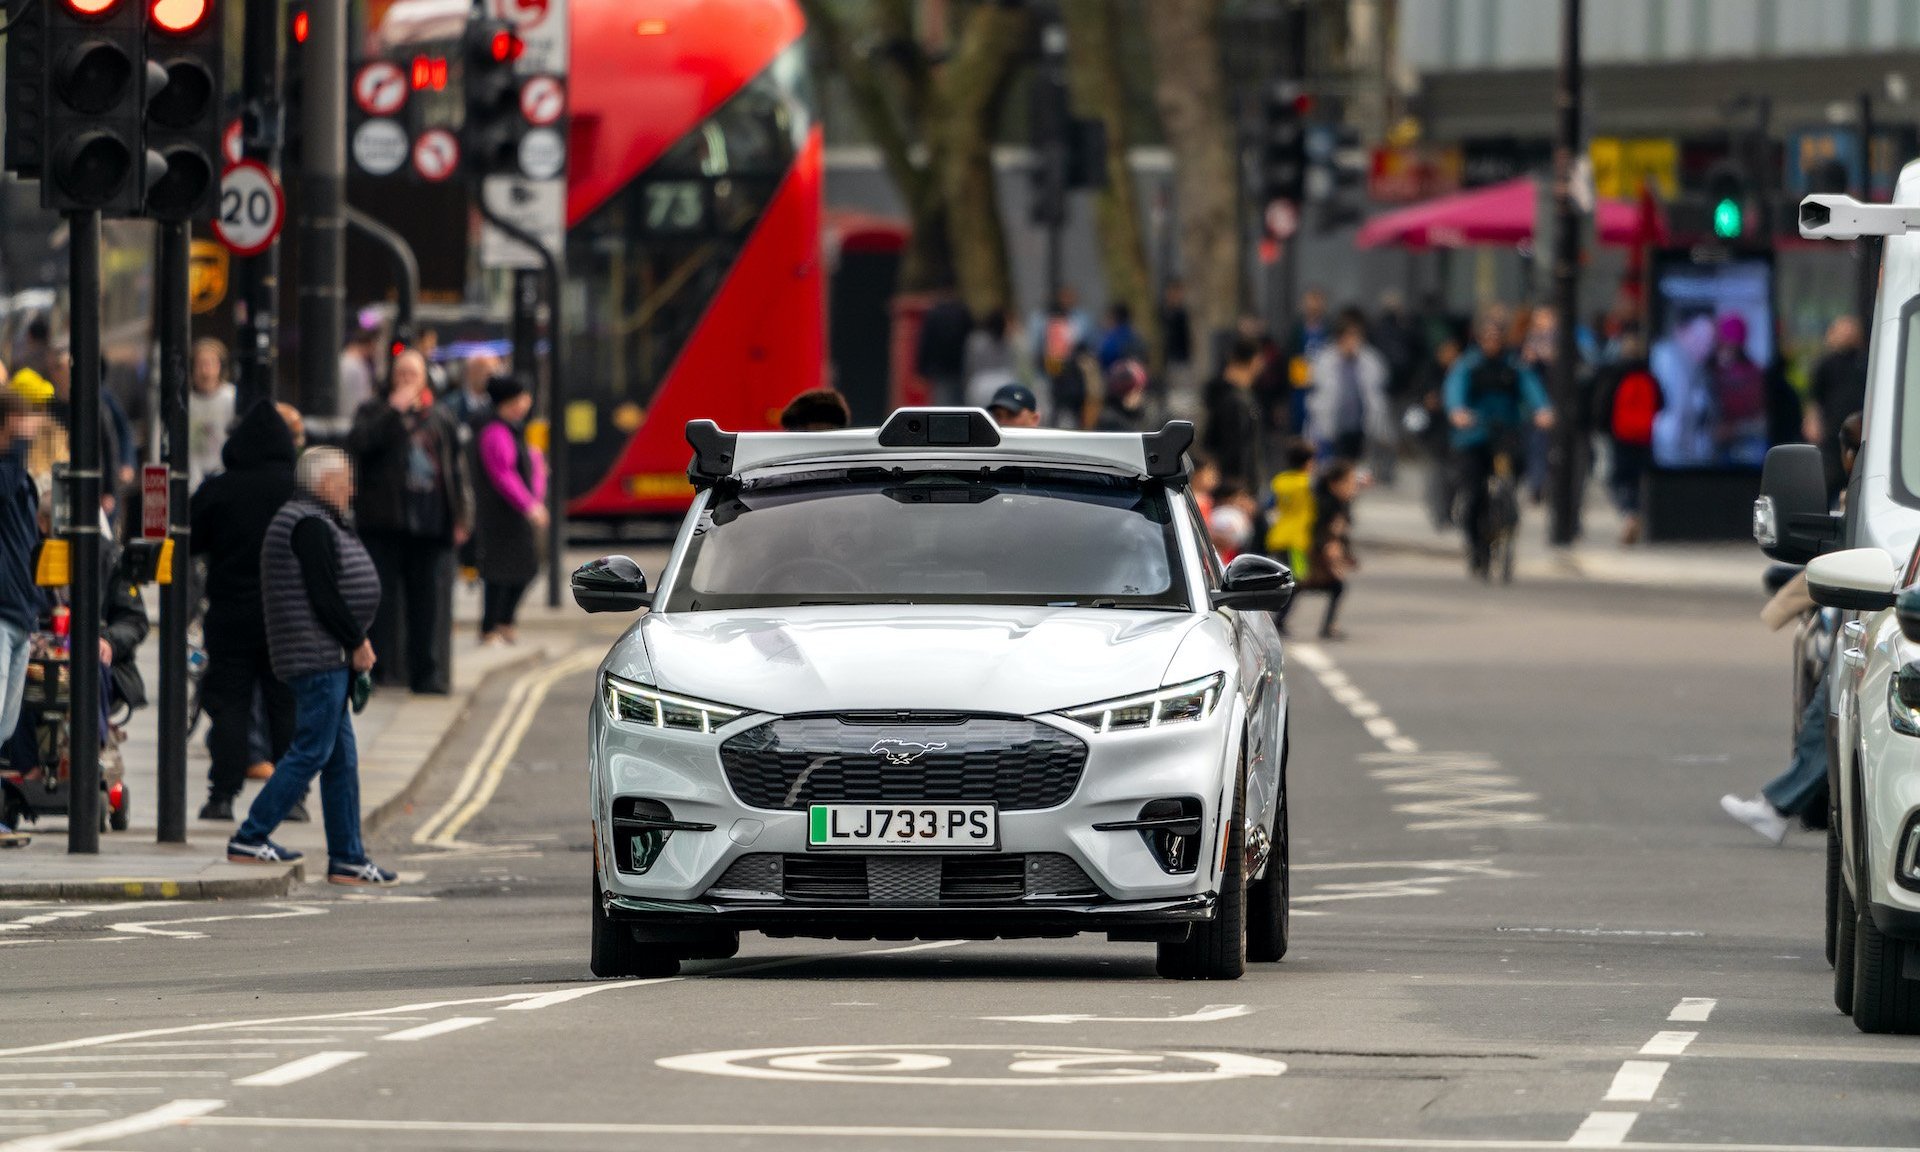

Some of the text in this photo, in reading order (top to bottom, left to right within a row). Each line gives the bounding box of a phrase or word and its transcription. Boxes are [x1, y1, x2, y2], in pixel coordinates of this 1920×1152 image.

[223, 188, 271, 226] 20
[647, 181, 702, 228] 73
[831, 809, 988, 838] LJ733 PS
